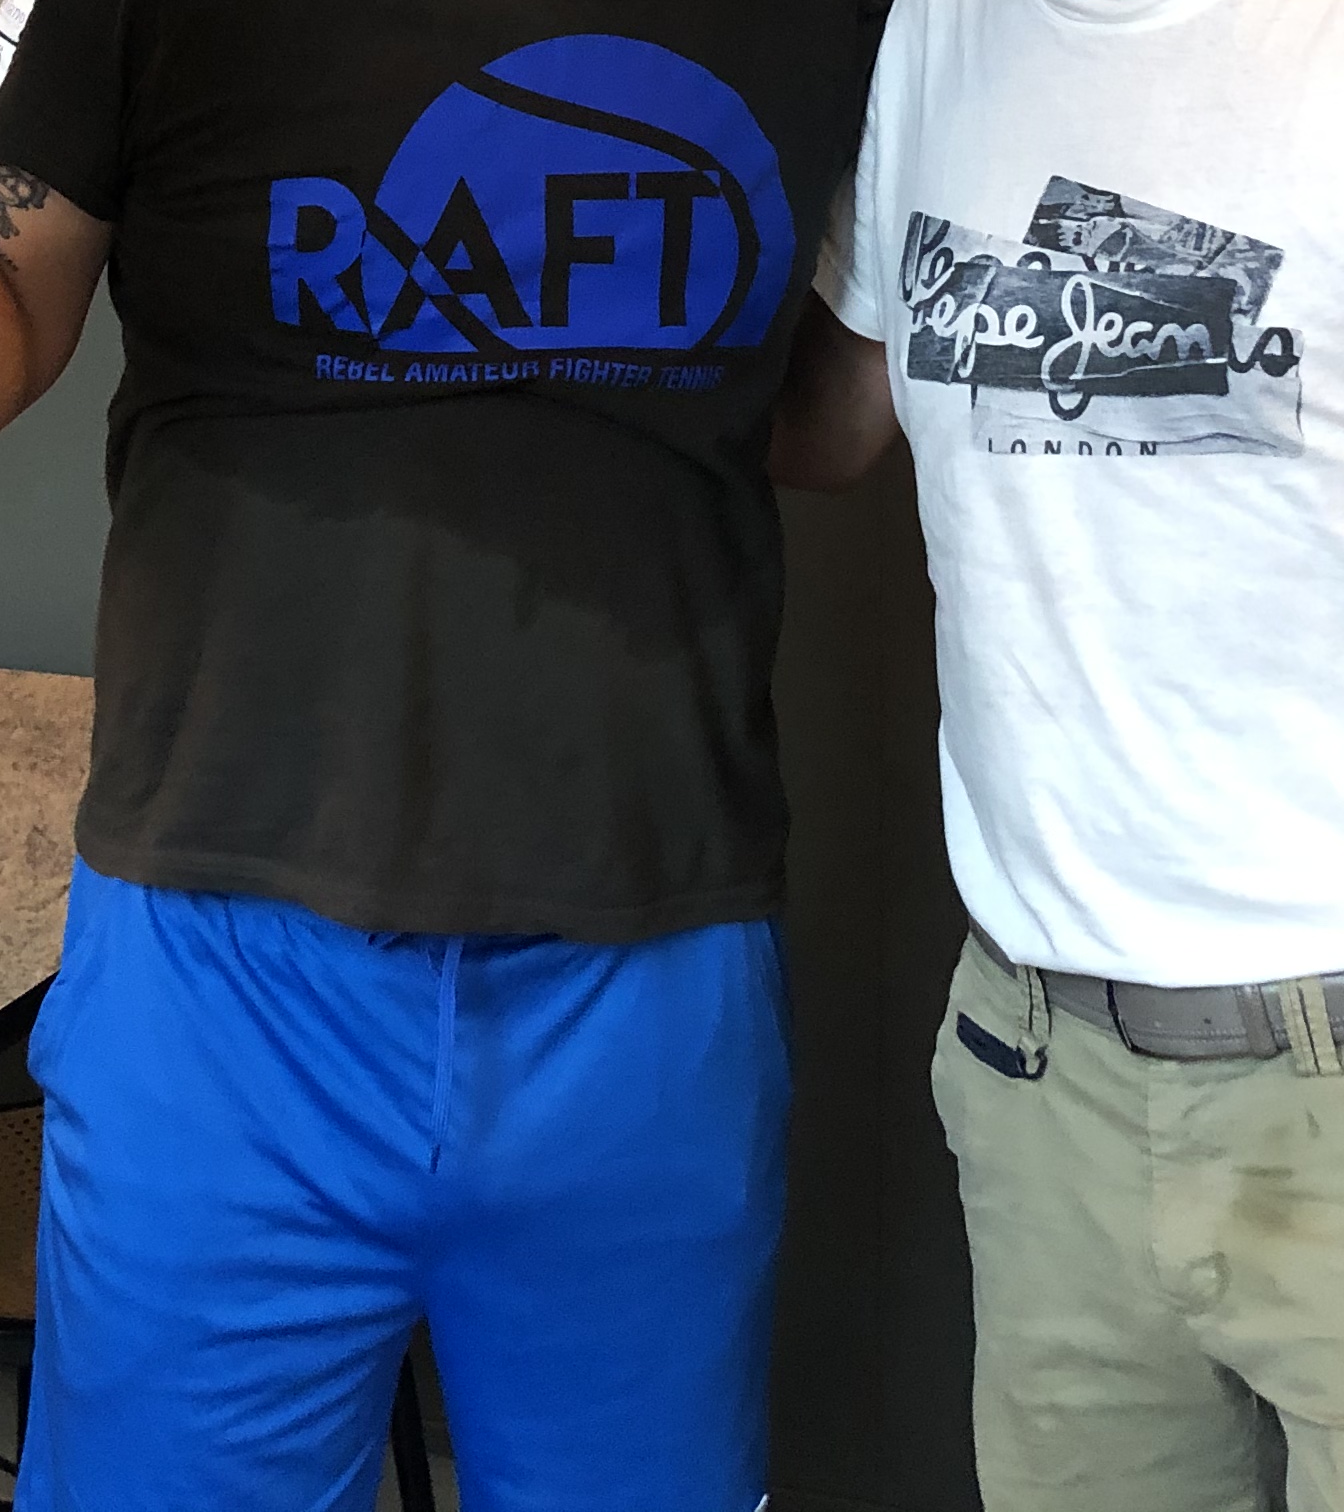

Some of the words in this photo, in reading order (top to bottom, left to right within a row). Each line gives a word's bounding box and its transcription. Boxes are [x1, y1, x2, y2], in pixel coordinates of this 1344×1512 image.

[267, 170, 721, 334] RAFT
[316, 354, 395, 382] REBEL
[404, 361, 540, 383] AMATEUR
[549, 358, 652, 387] FIGHTER
